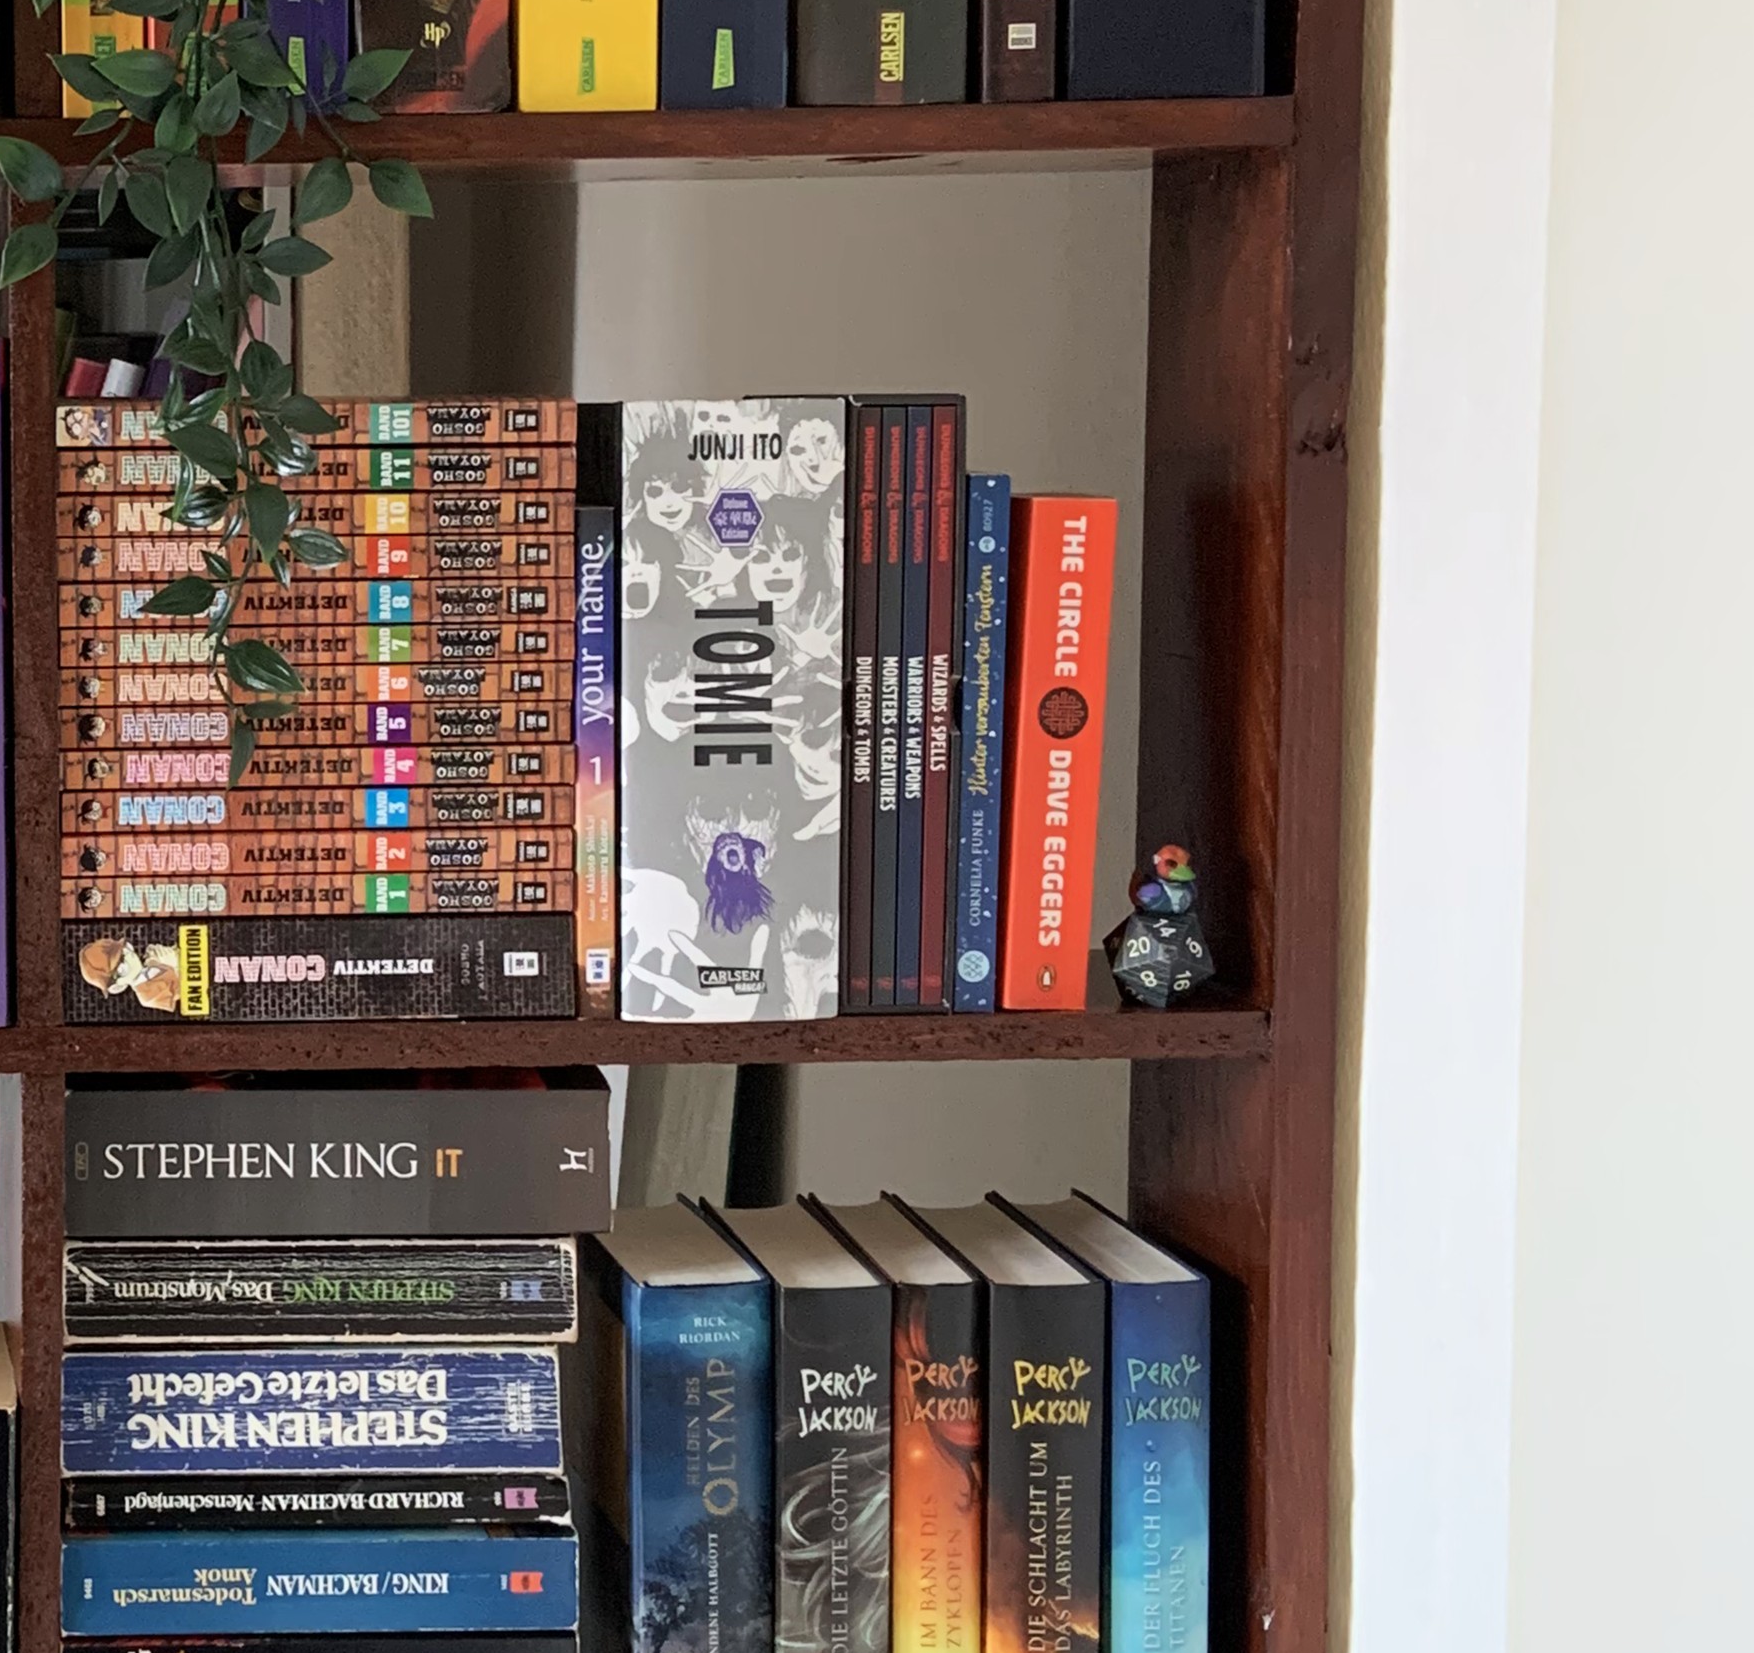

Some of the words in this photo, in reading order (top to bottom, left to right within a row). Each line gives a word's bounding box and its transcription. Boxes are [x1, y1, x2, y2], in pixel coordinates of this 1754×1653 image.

[880, 12, 901, 81] CARLSEN
[688, 435, 746, 462] JUNJI
[752, 434, 782, 457] ITO
[1060, 516, 1087, 573] THE
[582, 534, 607, 642] name.
[1054, 581, 1082, 677] CIRCLE
[582, 652, 613, 724] your
[693, 600, 774, 765] TOMIE
[905, 656, 923, 726] WARRIORS
[592, 757, 603, 785] 1
[906, 738, 921, 799] WEAPONS
[1045, 750, 1072, 827] DAVE
[1039, 835, 1065, 947] EGGERS
[1128, 937, 1150, 956] 20
[1154, 918, 1176, 937] 14
[185, 928, 202, 975] EDITION
[214, 955, 325, 985] CONAN
[332, 957, 434, 976] DETEKTIV
[185, 979, 202, 1014] FAN
[103, 1144, 294, 1178] STEPHEN
[310, 1143, 418, 1178] KING
[436, 1149, 462, 1177] IT
[797, 1405, 877, 1438] JACKSON
[113, 1587, 257, 1606] Todesmarsch
[195, 1568, 257, 1585] Amok
